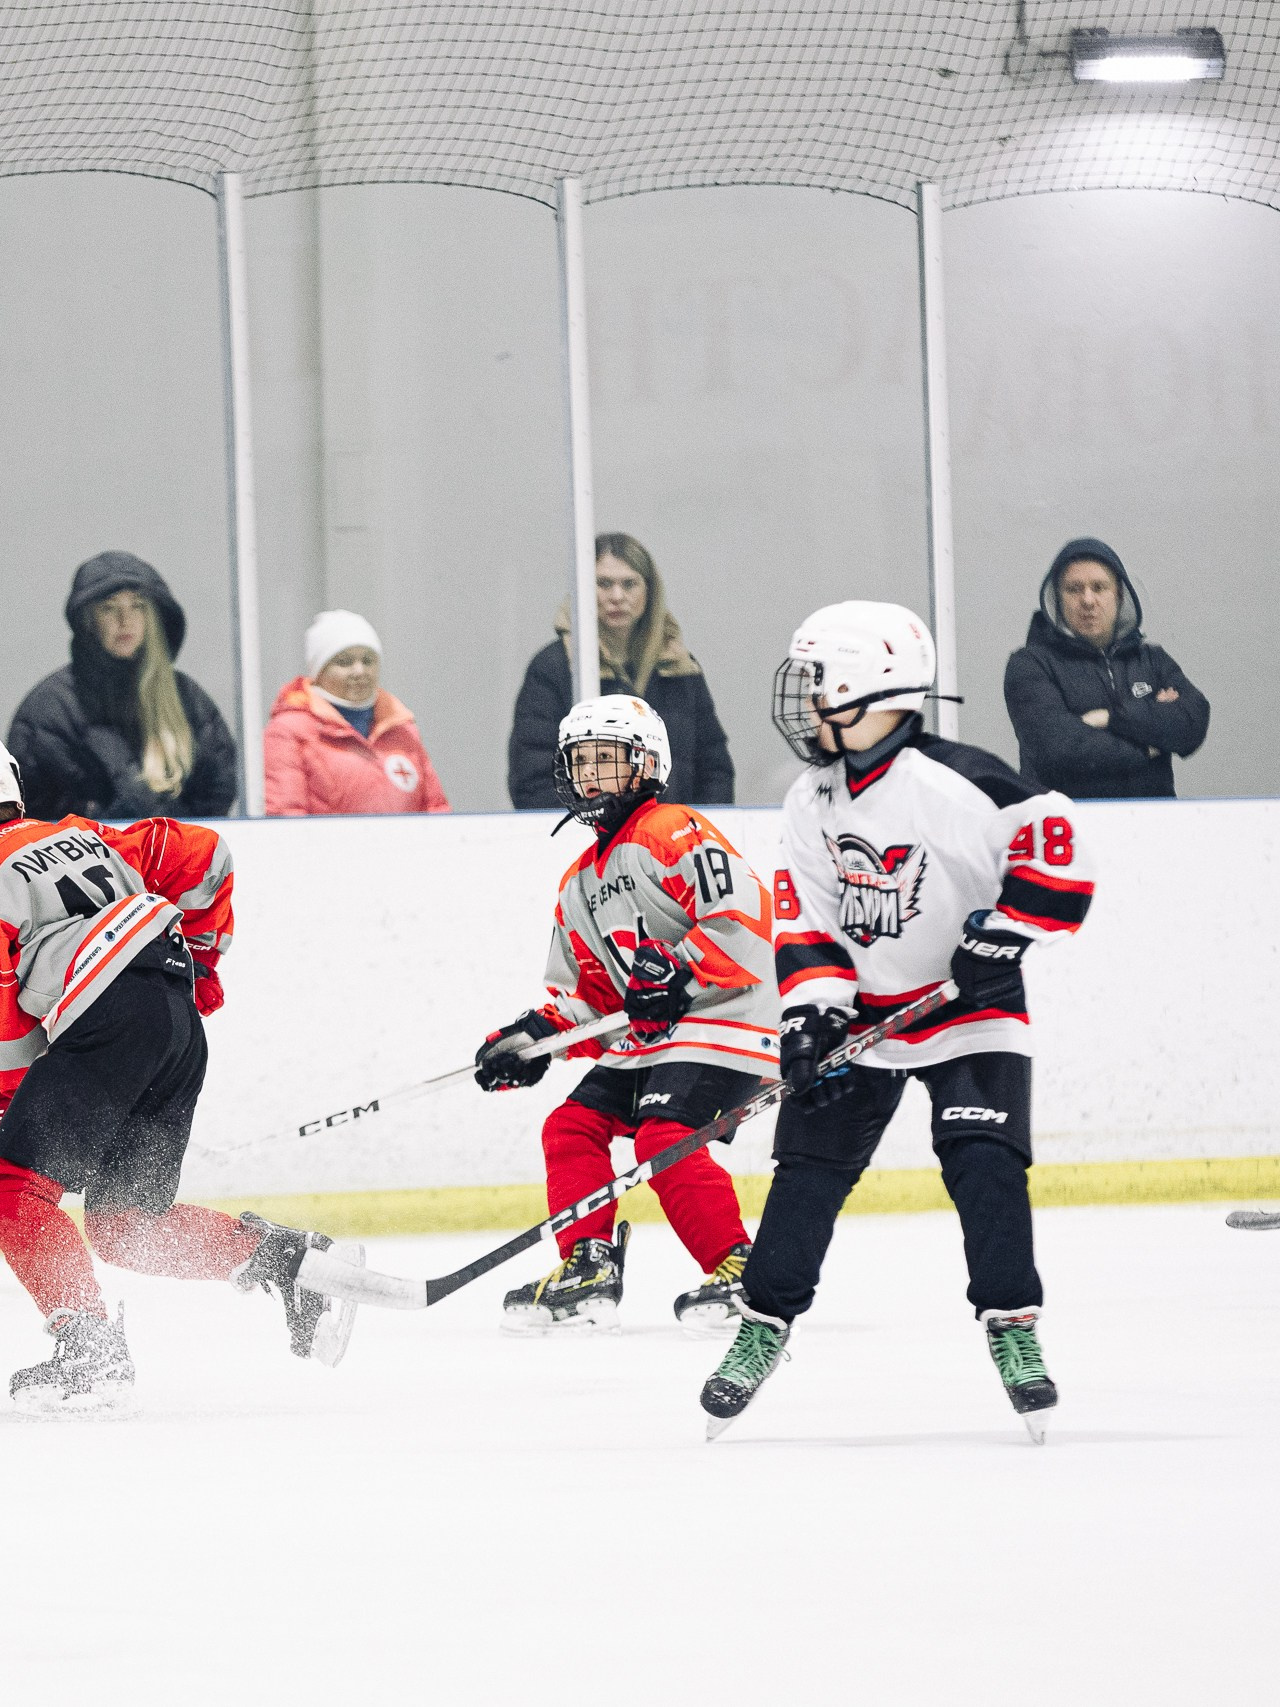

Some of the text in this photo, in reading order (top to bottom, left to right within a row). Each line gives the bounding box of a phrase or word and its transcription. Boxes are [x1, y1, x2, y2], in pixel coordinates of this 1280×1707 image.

[1008, 816, 1075, 866] 98
[693, 847, 734, 904] 19
[298, 1099, 380, 1137] CCM
[941, 1106, 1009, 1124] CCM
[539, 1161, 653, 1240] CCM
